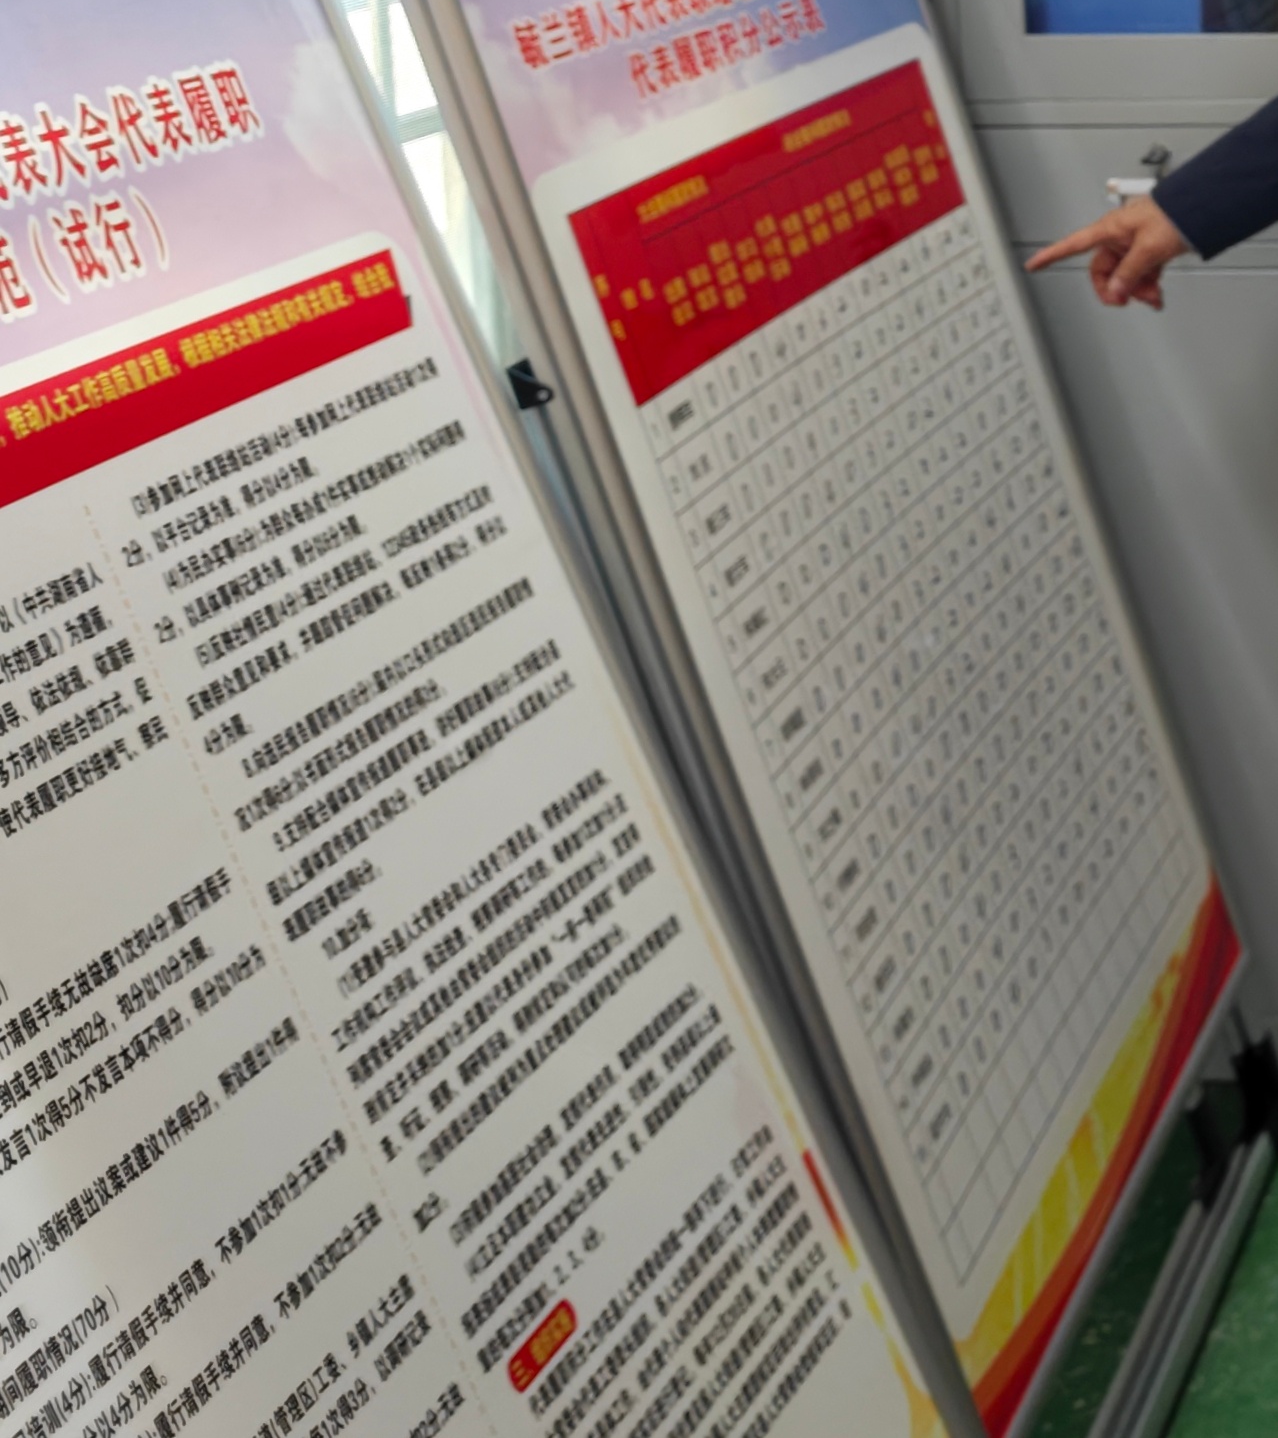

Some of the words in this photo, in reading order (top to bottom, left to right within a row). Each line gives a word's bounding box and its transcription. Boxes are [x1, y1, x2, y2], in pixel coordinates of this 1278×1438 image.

[0, 66, 261, 202] 表大会代表履职
